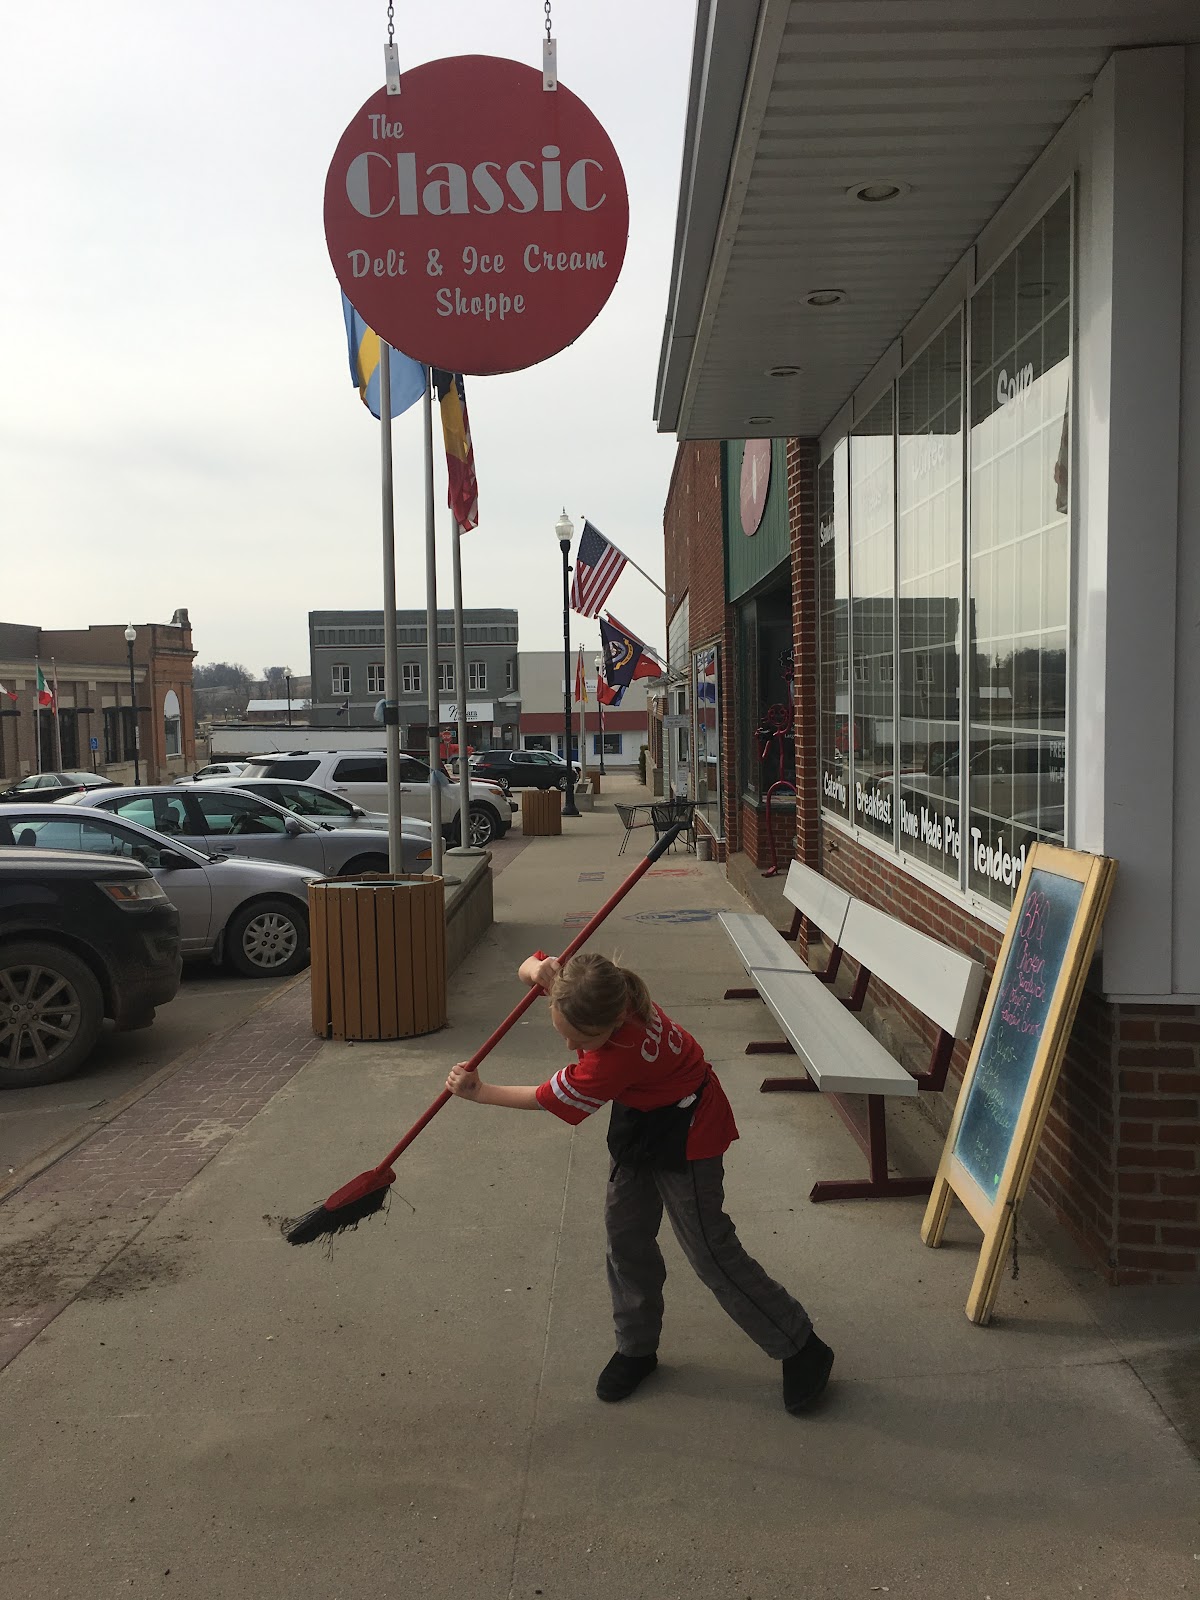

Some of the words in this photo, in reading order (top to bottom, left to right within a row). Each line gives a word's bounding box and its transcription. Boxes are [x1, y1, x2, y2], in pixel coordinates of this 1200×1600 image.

[369, 114, 404, 139] The
[346, 145, 607, 218] Classic
[347, 249, 407, 278] Deli
[426, 248, 443, 276] &
[462, 246, 505, 275] Ice
[524, 244, 607, 273] Cream
[436, 287, 526, 320] Shoppe
[997, 362, 1033, 405] Soup
[824, 770, 846, 809] Catering
[856, 781, 892, 824] Breakfast
[900, 798, 918, 839] Home
[921, 806, 943, 850] Made
[1020, 891, 1051, 949] BBQ
